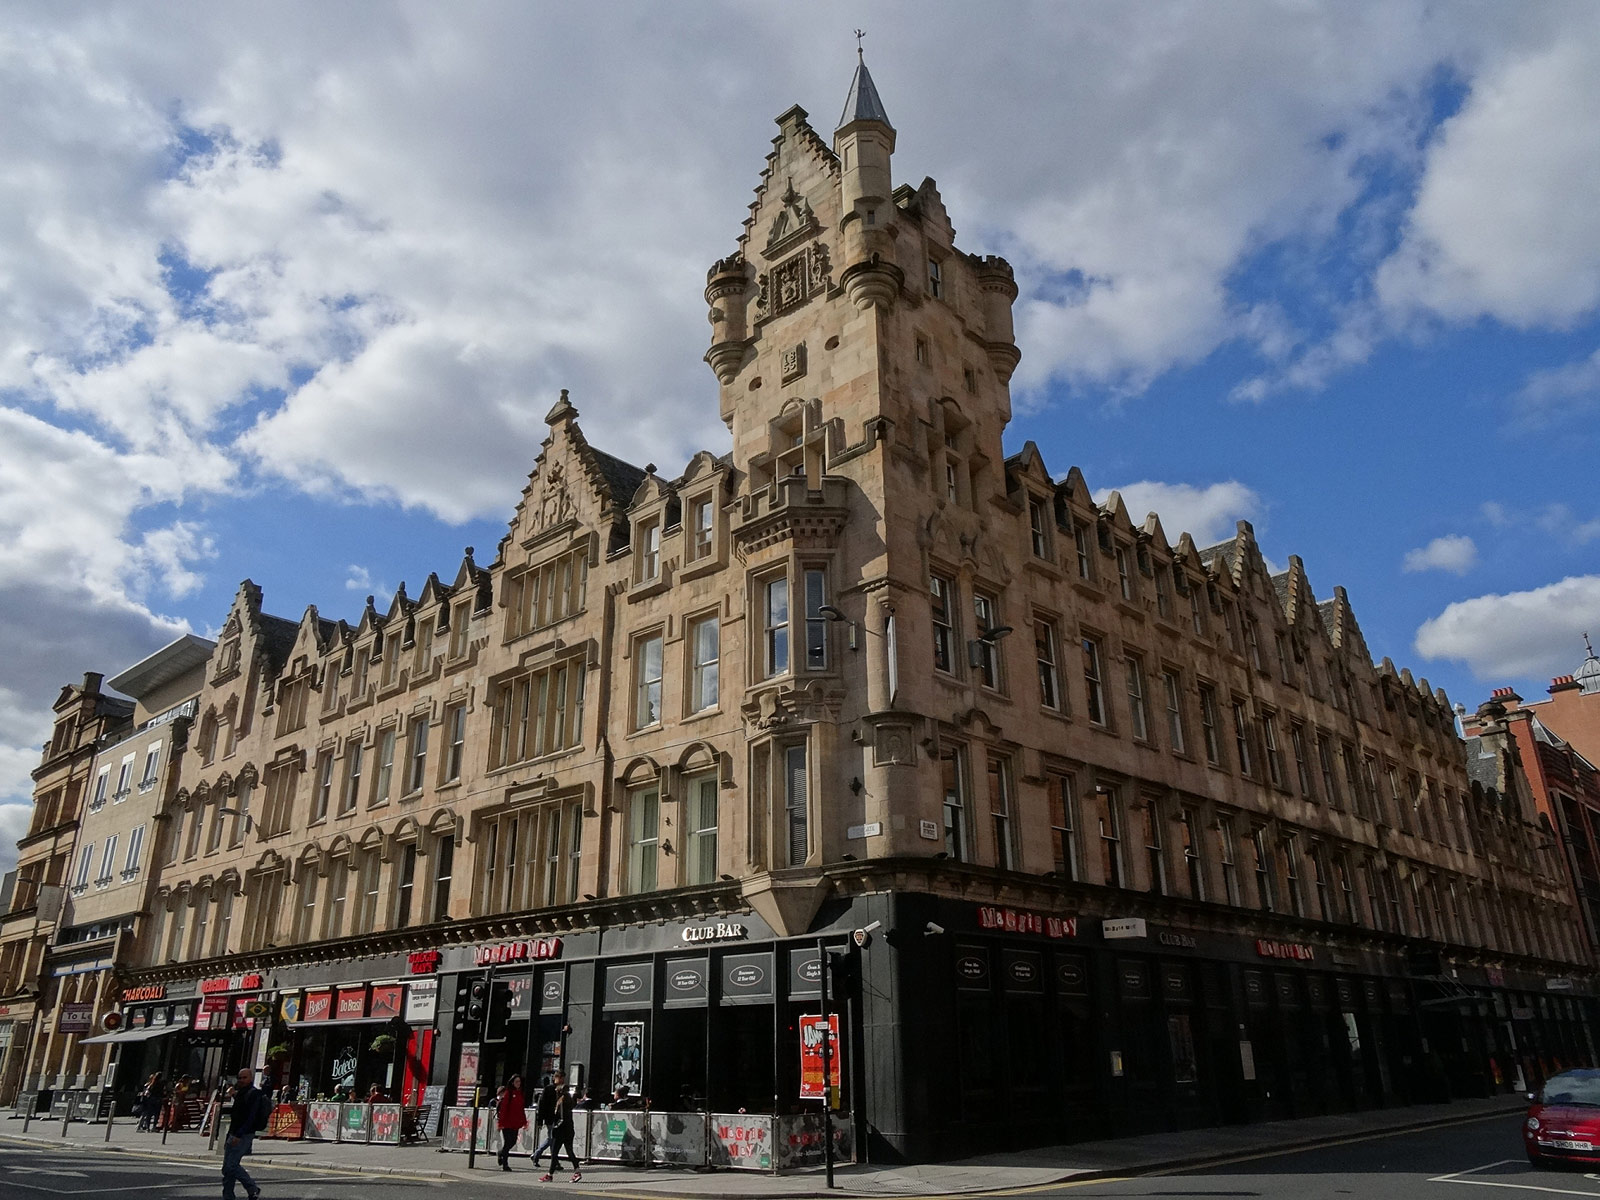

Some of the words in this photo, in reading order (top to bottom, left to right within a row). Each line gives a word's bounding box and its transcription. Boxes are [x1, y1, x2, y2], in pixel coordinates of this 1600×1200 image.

[682, 927, 714, 942] CLUB
[717, 923, 742, 941] BAR
[122, 986, 165, 1001] CHARCOALS
[340, 1000, 348, 1013] Do
[350, 997, 364, 1012] Brasil
[67, 1012, 78, 1020] To
